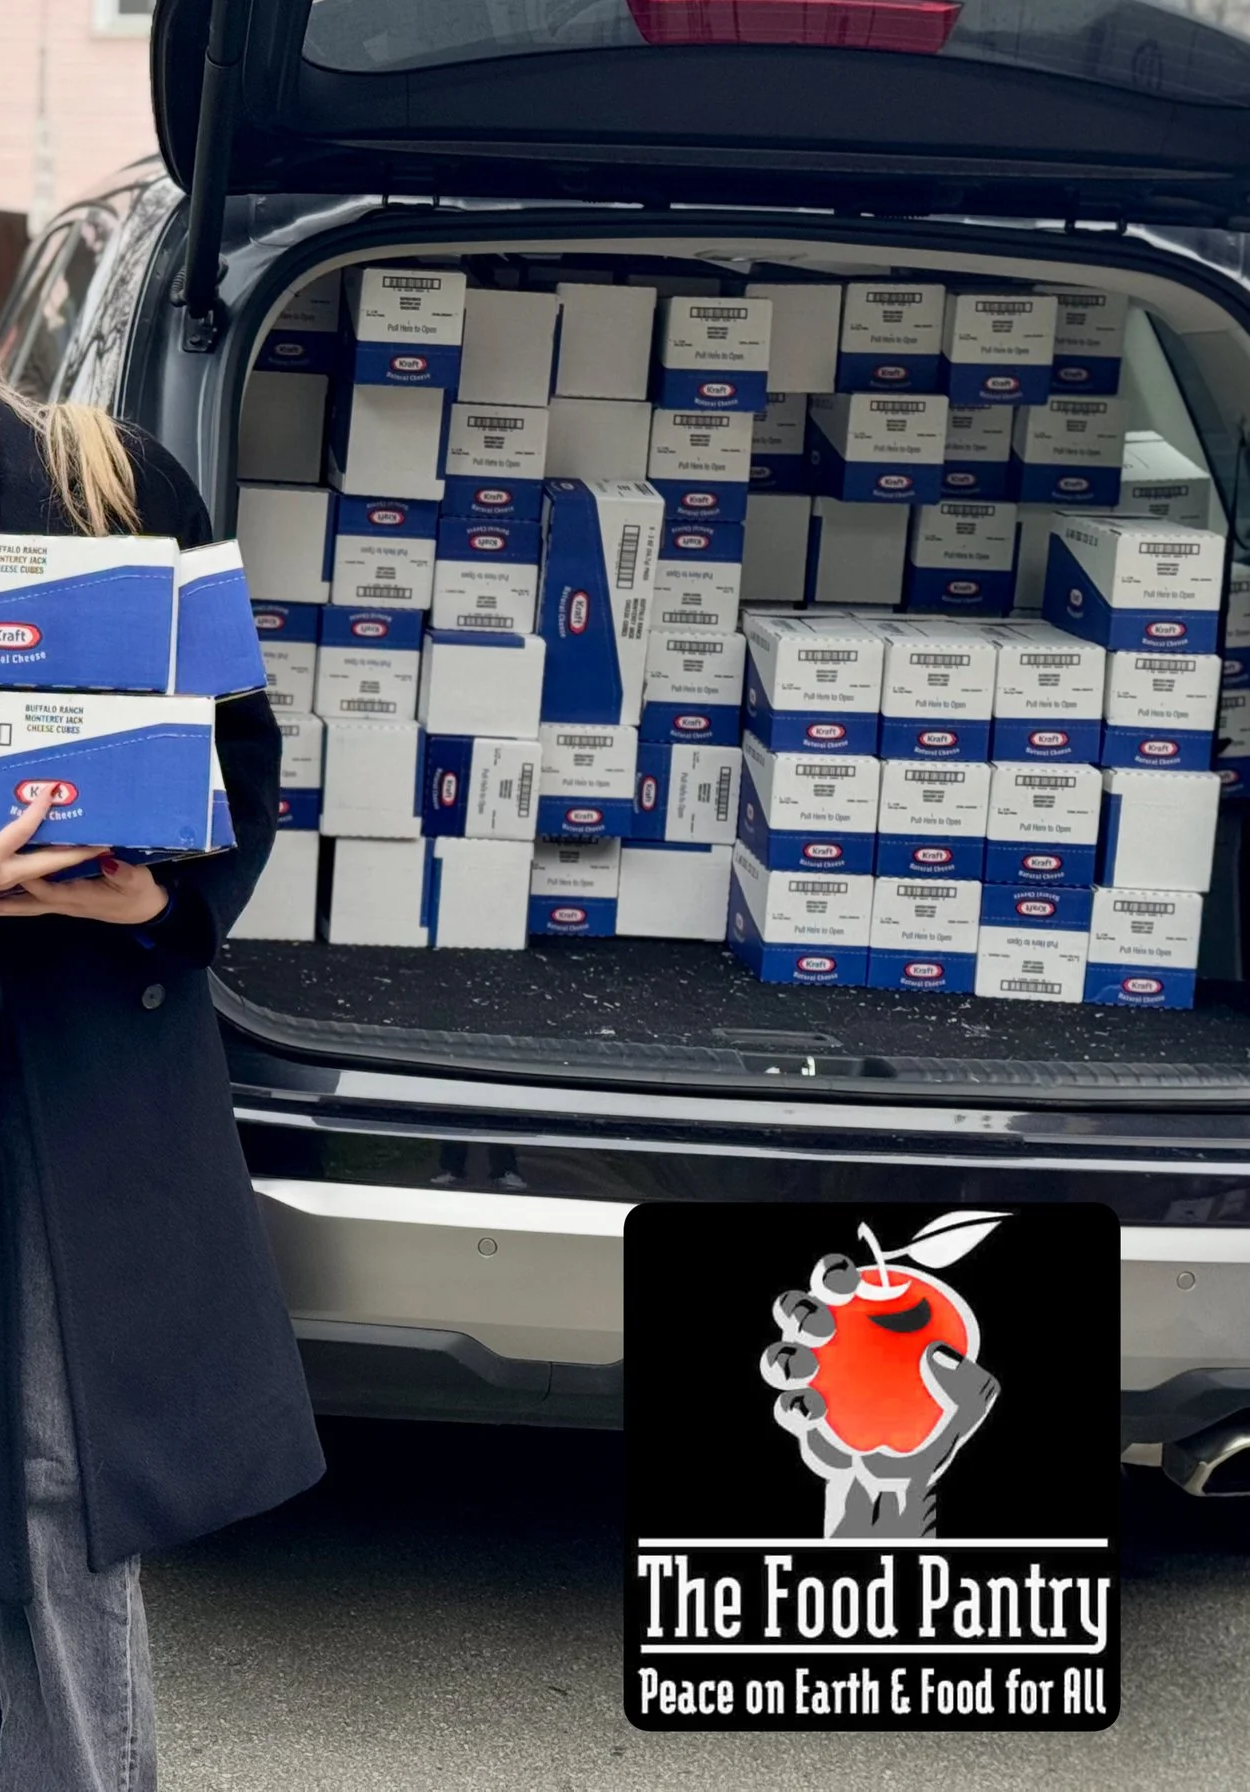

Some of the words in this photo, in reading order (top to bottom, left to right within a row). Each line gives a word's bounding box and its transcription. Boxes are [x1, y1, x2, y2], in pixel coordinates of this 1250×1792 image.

[399, 359, 420, 369] Kraft
[991, 379, 1012, 388] Kraft
[706, 385, 727, 395] Kraft
[884, 477, 904, 486] Kraft
[484, 492, 503, 501] Kraft
[377, 513, 397, 522] Kraft
[22, 546, 47, 555] RANCH
[29, 556, 47, 564] JACK
[20, 565, 44, 574] CUBES
[571, 599, 586, 626] Kraft
[1154, 625, 1176, 635] Kraft
[12, 651, 47, 664] Cheese
[25, 704, 57, 713] BUFFALO
[59, 705, 84, 714] RANCH
[25, 714, 63, 723] MONTEREY
[66, 715, 83, 724] JACK
[682, 718, 702, 727] Kraft
[26, 724, 54, 733] CHEESE
[56, 725, 80, 734] CUBES
[815, 726, 836, 736] Kraft
[926, 733, 948, 743] Kraft
[1038, 734, 1060, 744] Kraft
[1147, 743, 1169, 753] Kraft
[49, 807, 83, 821] Cheese
[573, 811, 594, 820] Kraft
[812, 846, 833, 856] Kraft
[922, 850, 943, 860] Kraft
[1030, 857, 1052, 867] Kraft
[1024, 902, 1047, 913] Kraft
[558, 911, 578, 919] Kraft
[805, 959, 827, 969] Kraft
[913, 965, 934, 975] Kraft
[1131, 980, 1153, 990] Kraft
